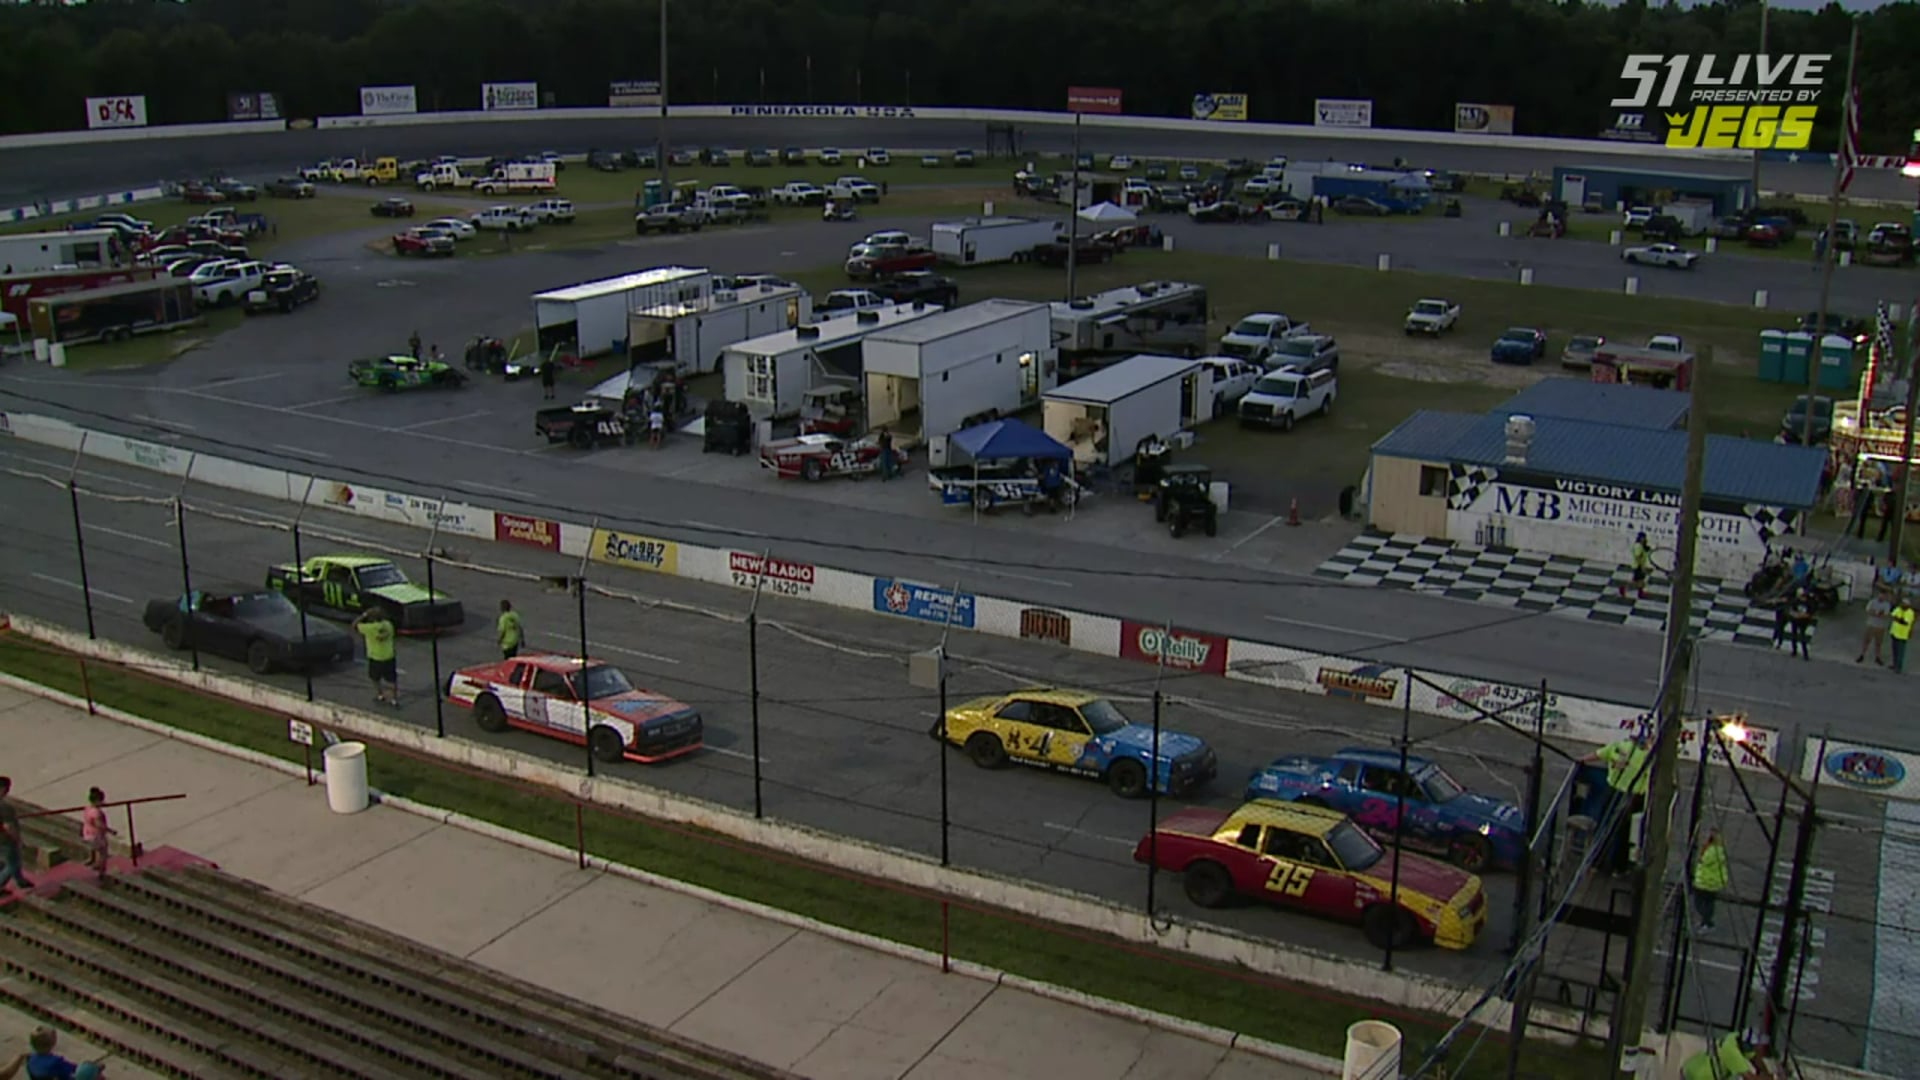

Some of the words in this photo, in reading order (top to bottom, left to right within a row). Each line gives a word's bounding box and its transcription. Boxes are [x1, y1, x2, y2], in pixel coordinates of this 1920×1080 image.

[731, 106, 857, 116] PENSACOLA
[1555, 479, 1634, 500] VICTORY
[1567, 514, 1622, 530] ACCIDENT
[1626, 522, 1635, 531] &
[1639, 523, 1680, 537] INJUR
[1568, 497, 1651, 524] MICHLES
[1655, 510, 1671, 524] &
[1675, 511, 1742, 536] OTH
[769, 559, 813, 581] RADIO
[772, 578, 799, 595] 1620
[1140, 629, 1207, 663] O'Reilly
[1264, 859, 1317, 898] 95
